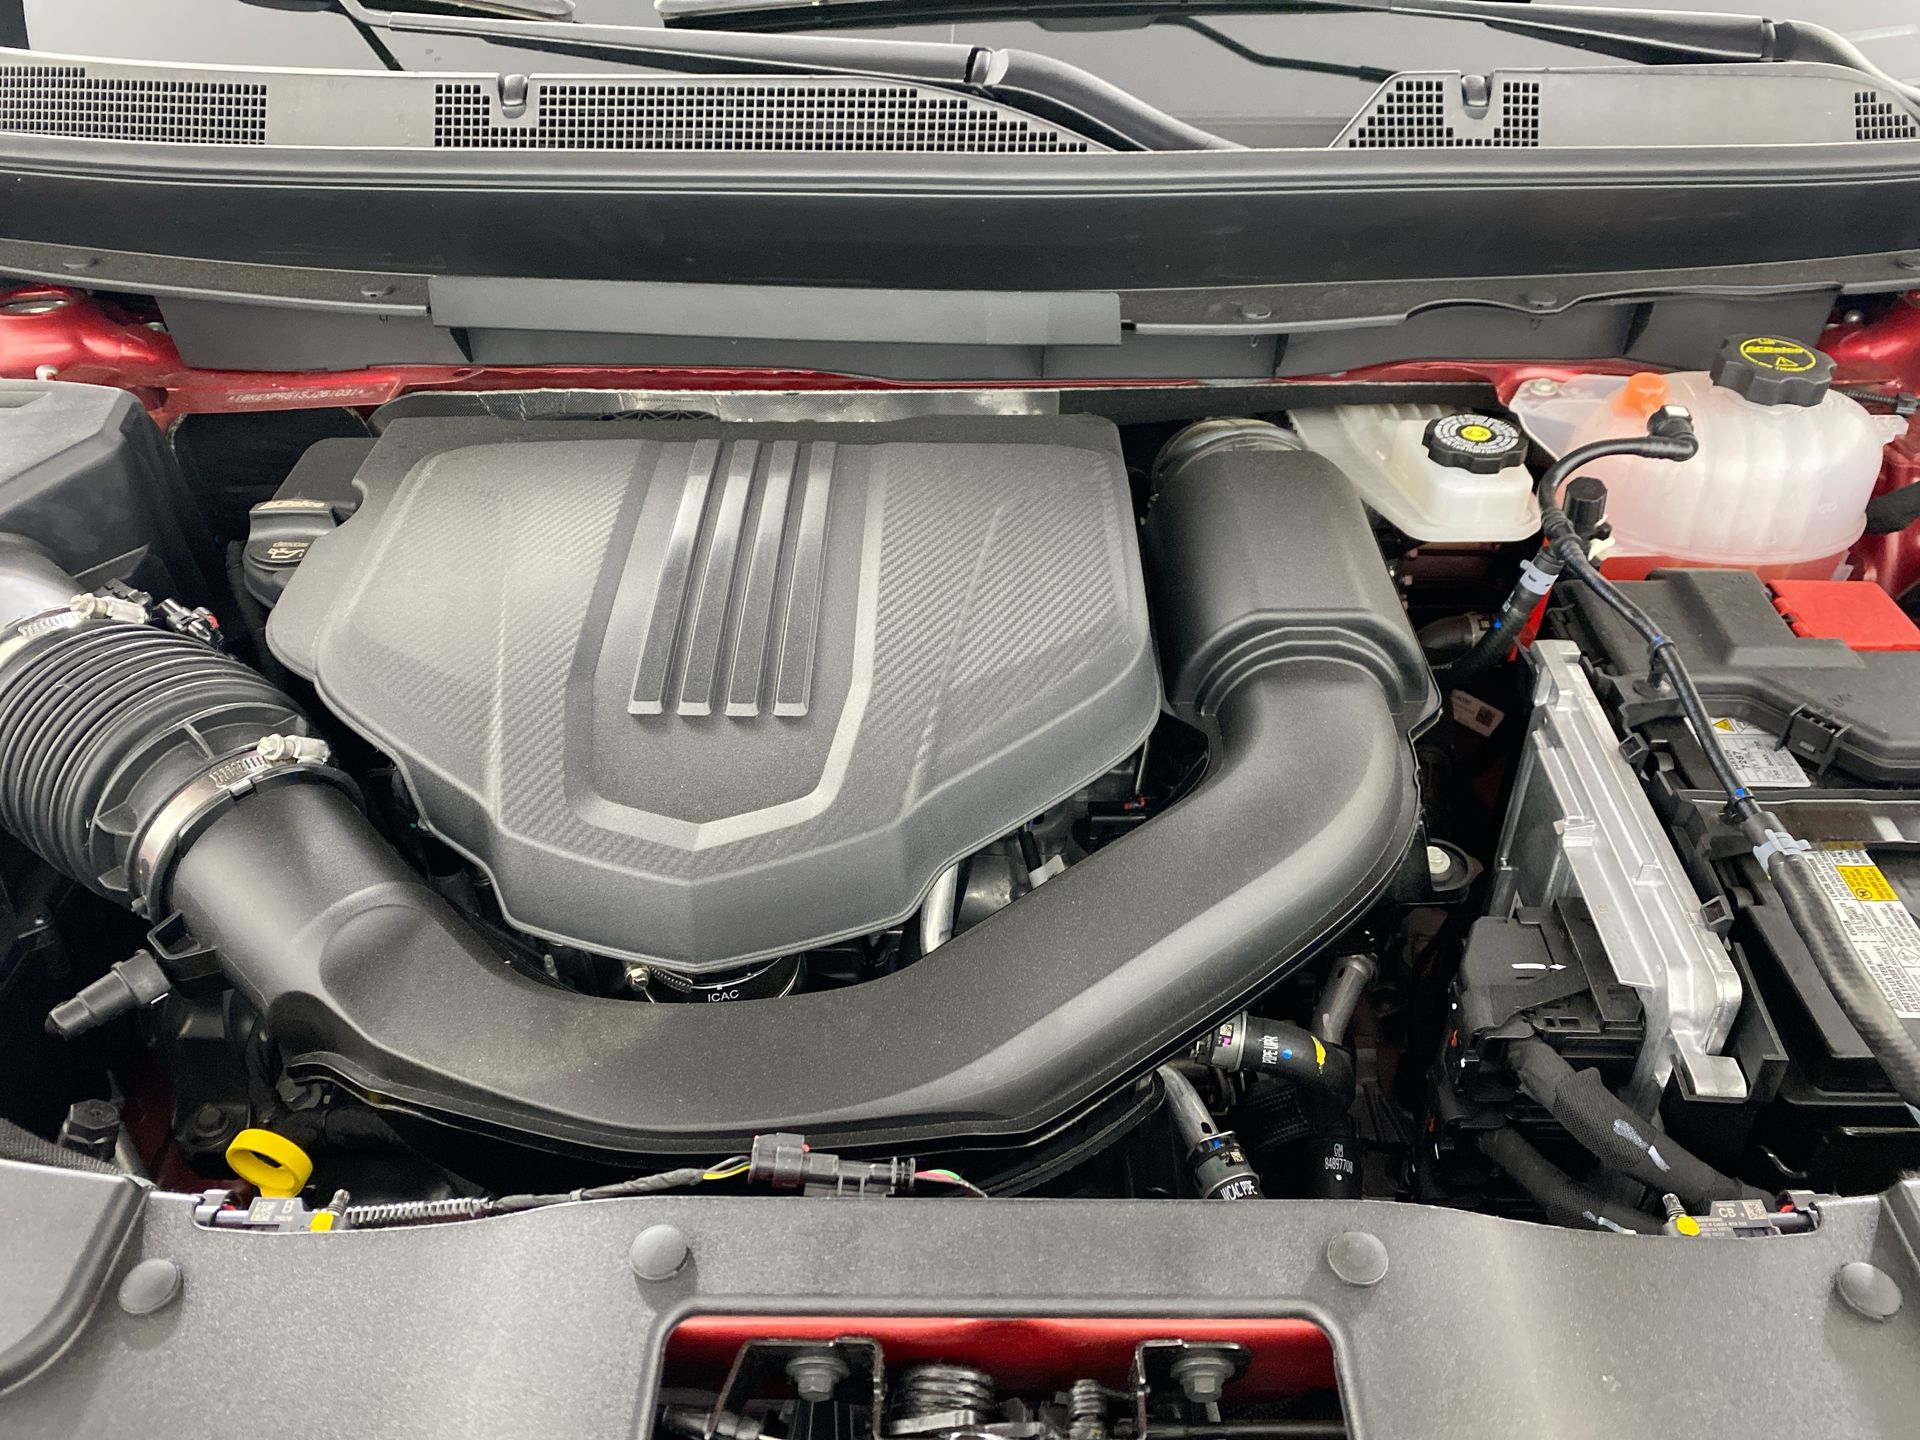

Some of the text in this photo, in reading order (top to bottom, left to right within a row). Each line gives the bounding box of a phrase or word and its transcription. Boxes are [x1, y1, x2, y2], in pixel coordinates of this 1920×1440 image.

[707, 989, 740, 1002] ICAC
[1262, 1050, 1278, 1064] PIPE
[1333, 1143, 1344, 1157] GM
[1239, 1180, 1258, 1196] PIPE
[281, 1199, 296, 1214] B
[1718, 1207, 1737, 1218] CB
